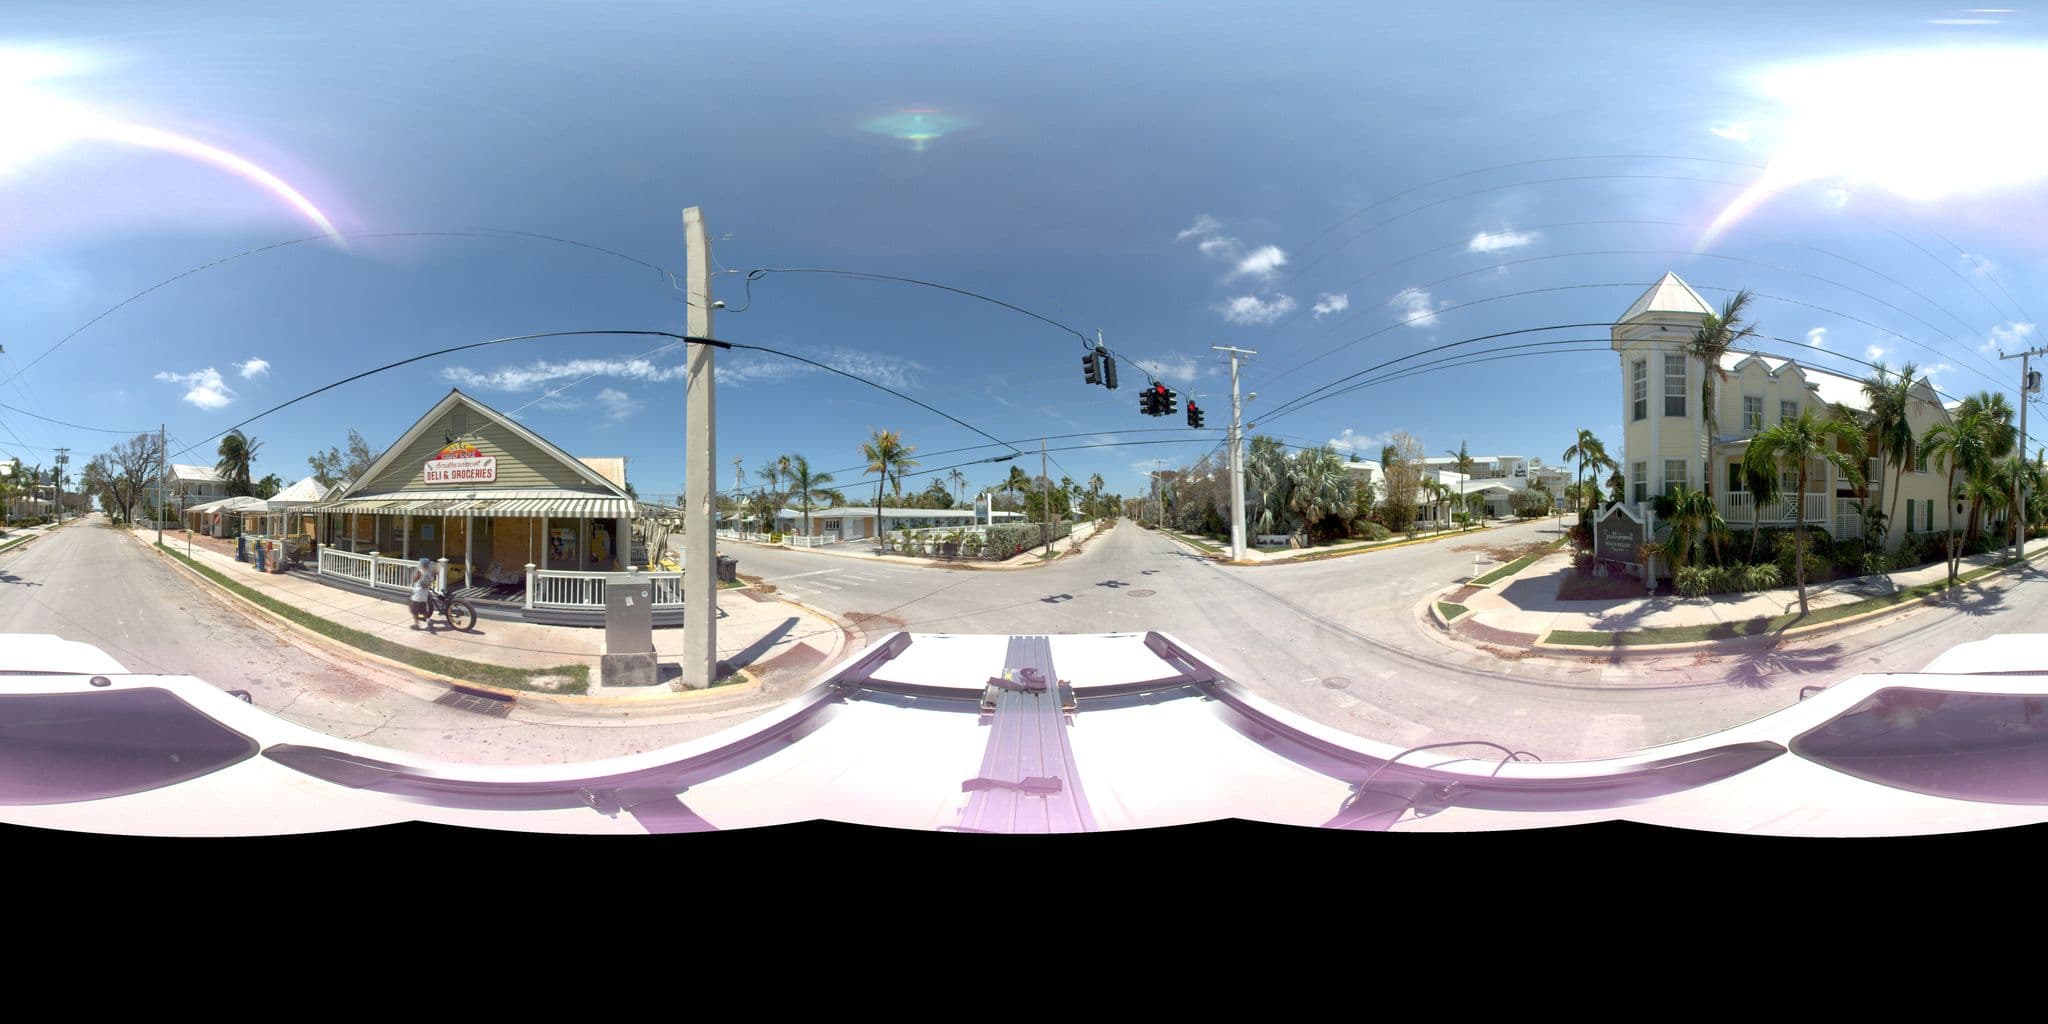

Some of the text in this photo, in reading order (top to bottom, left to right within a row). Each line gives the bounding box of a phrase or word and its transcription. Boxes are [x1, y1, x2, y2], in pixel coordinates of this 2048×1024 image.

[427, 468, 493, 481] DELI & GROCERIES
